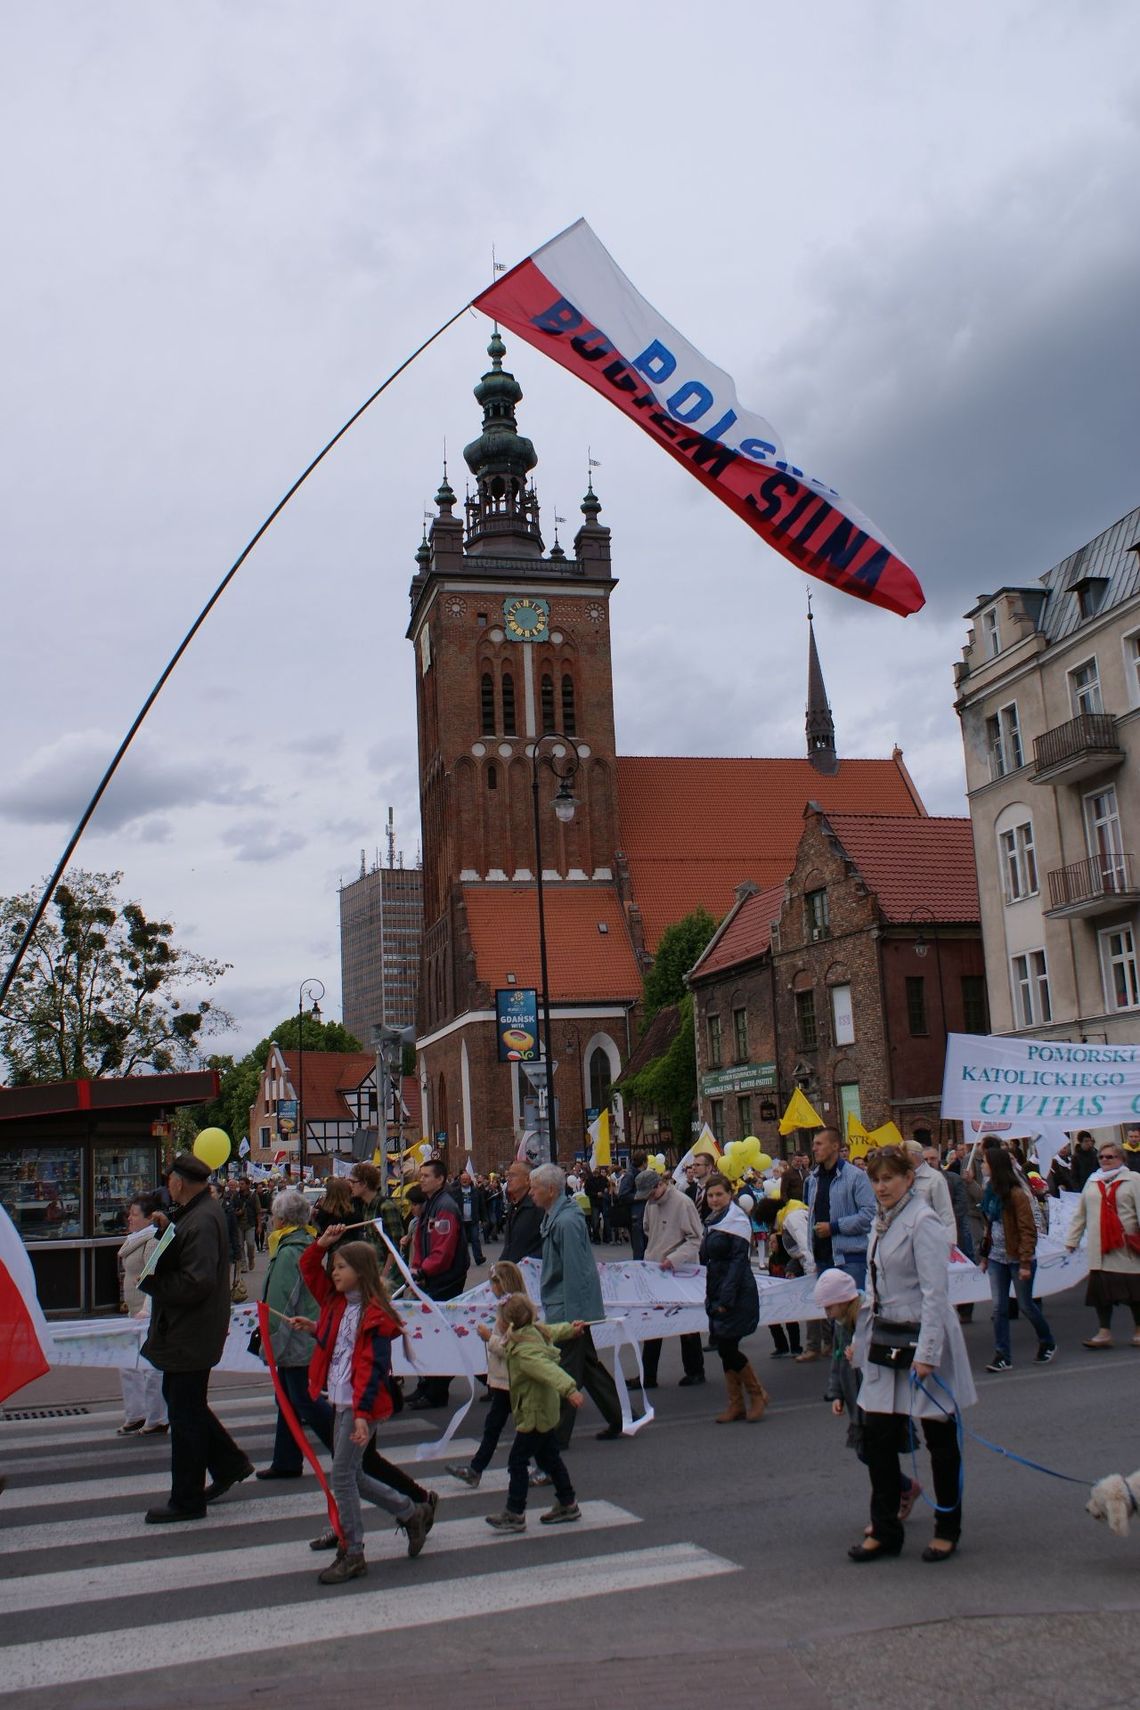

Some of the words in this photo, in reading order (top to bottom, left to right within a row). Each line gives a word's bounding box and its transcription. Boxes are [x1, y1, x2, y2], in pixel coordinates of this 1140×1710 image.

[631, 339, 838, 495] POLS
[746, 472, 891, 596] SILNA
[500, 1014, 535, 1023] GDAŃSK
[961, 1065, 1125, 1087] KATOLICKIEGO
[979, 1093, 1106, 1116] CIVITAS
